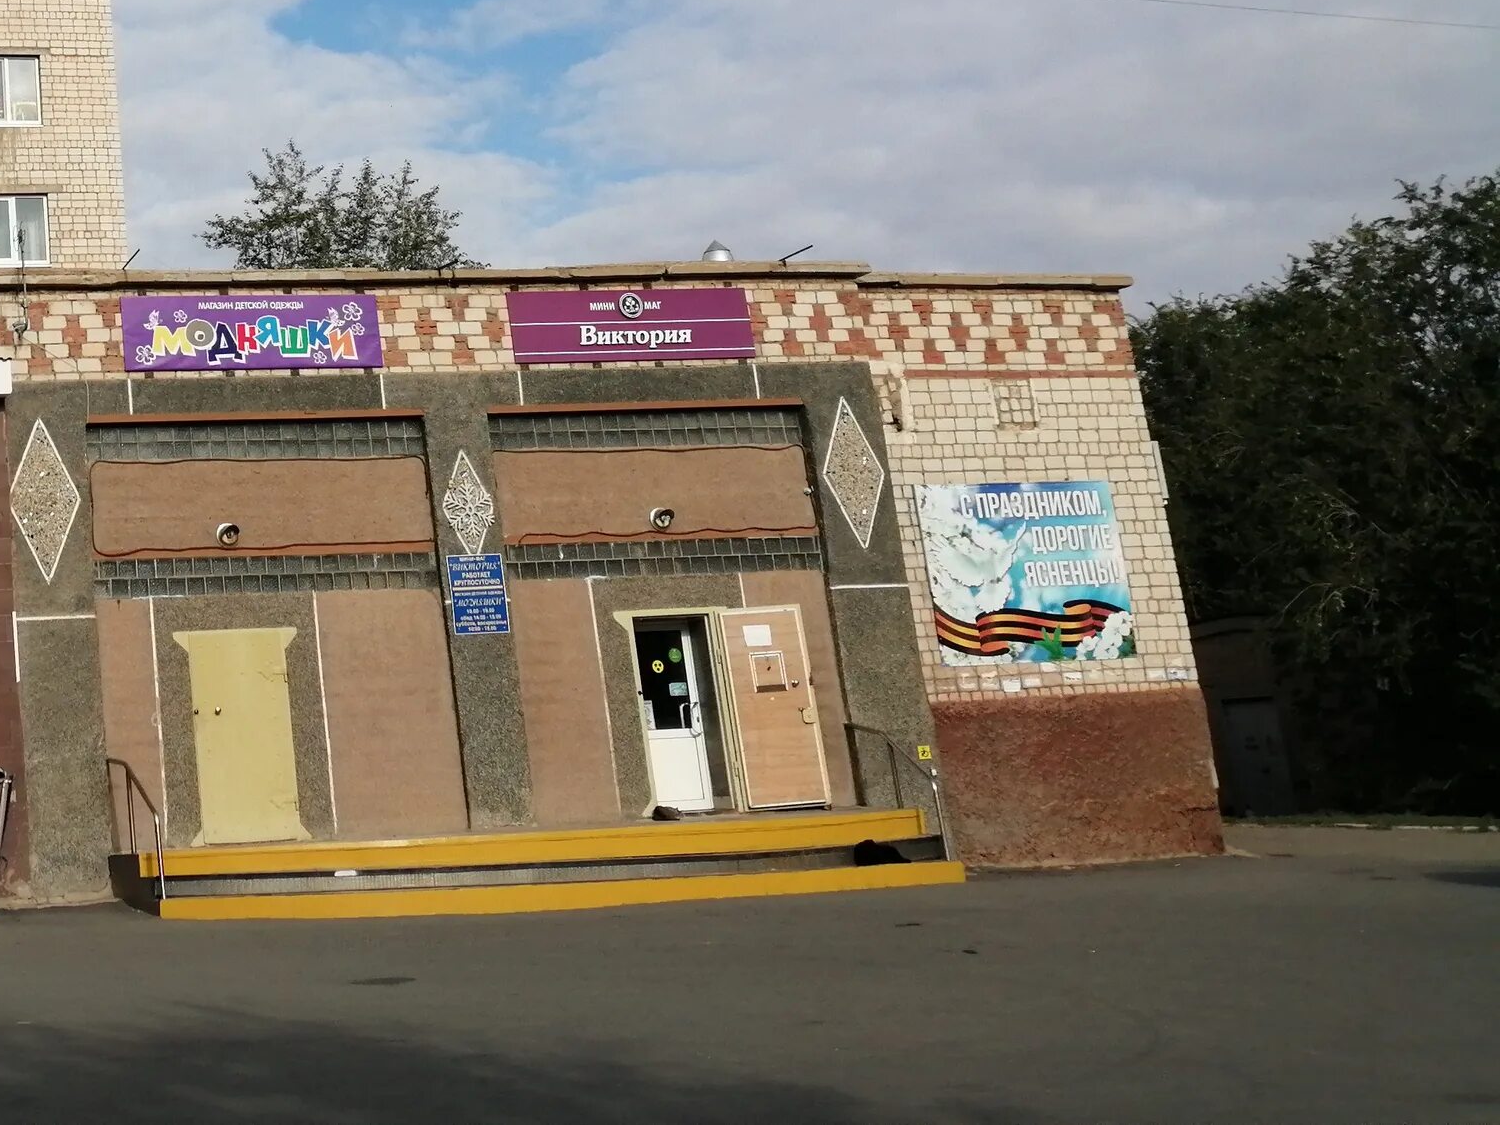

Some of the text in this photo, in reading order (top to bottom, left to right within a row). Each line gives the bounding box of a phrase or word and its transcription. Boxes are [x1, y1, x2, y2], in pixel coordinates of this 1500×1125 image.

[198, 300, 304, 311] МАГАЗИН ДЕТСКОЙ ОДЕЖДЫ
[589, 301, 662, 311] МИНИ МАГ
[579, 325, 692, 349] Виктория
[960, 490, 1108, 520] С ПРАЗДНИКОМ,
[1031, 524, 1114, 555] ДОРОГИЕ
[453, 578, 500, 587] КРУГЛОСУТОЧНО
[1023, 558, 1121, 588] ЯСНЕНЦЫ!
